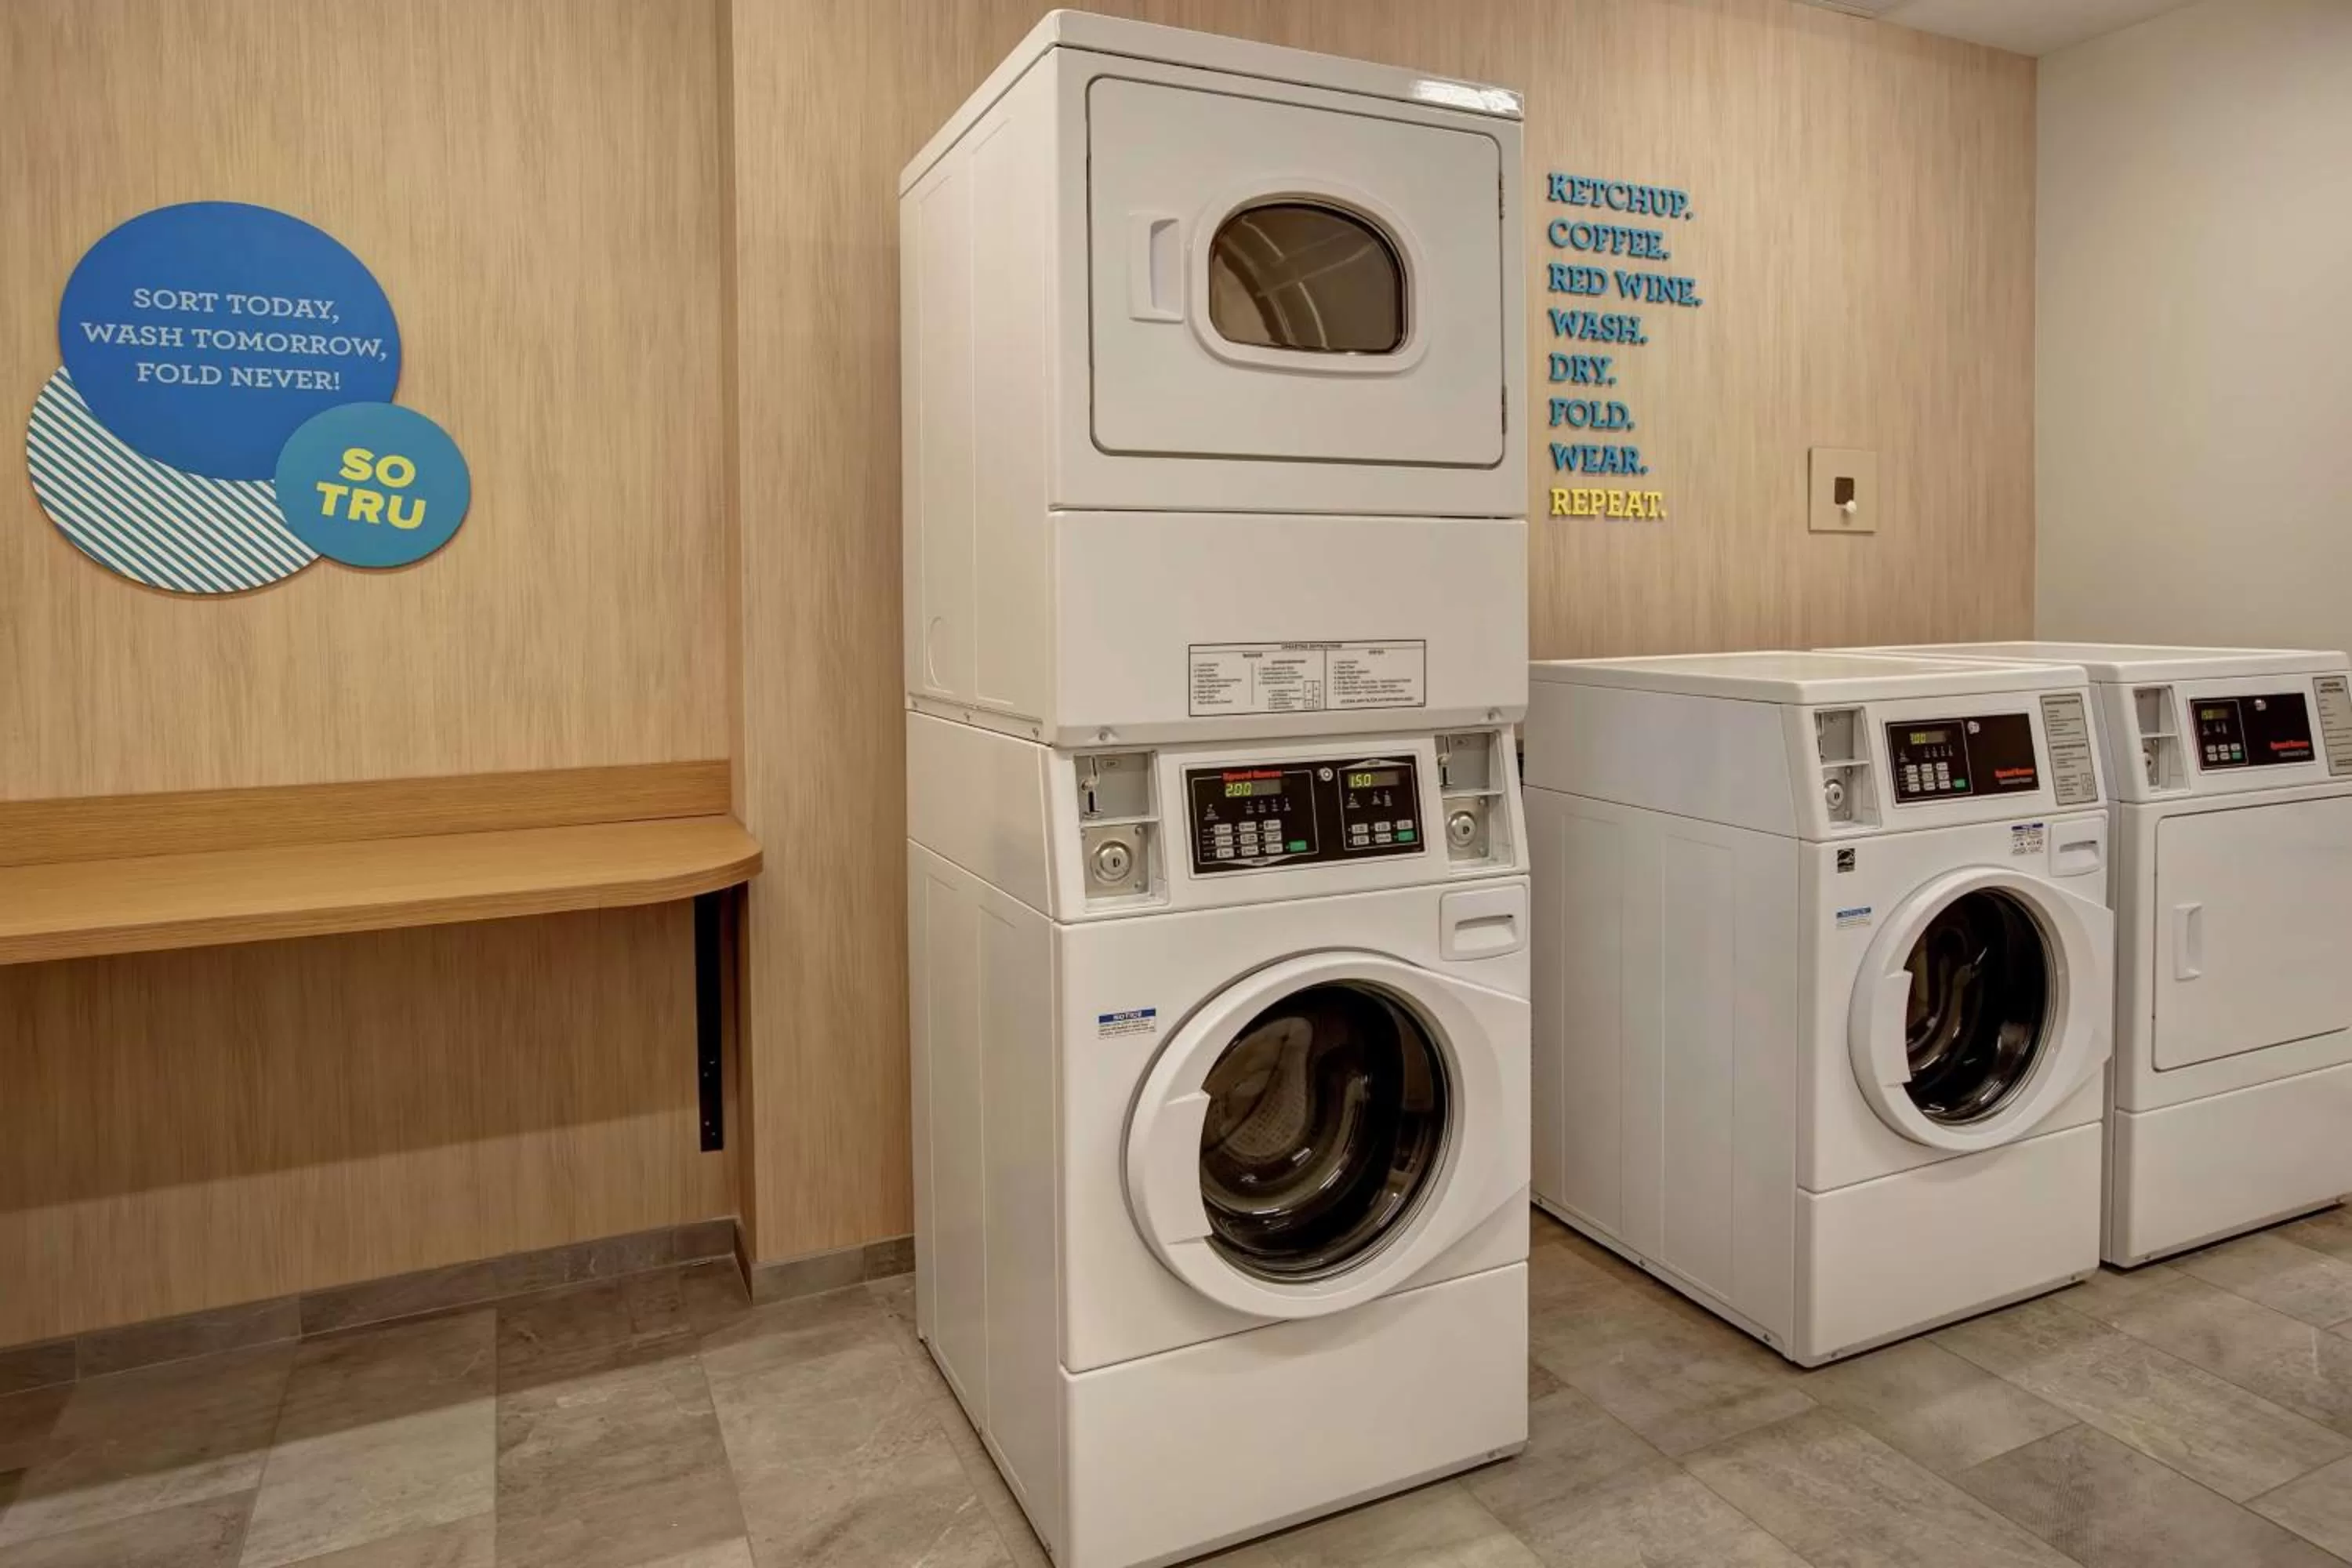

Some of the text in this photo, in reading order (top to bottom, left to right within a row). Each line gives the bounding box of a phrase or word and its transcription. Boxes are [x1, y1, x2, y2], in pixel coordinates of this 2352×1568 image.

[1548, 173, 1693, 219] KETCHUP.
[1548, 220, 1670, 260] COFFEE.
[1548, 263, 1703, 307] RED WINE.
[134, 288, 339, 325] SORT TODAY,
[81, 322, 387, 361] WASH TOMORROW,
[1548, 308, 1648, 343] WASH.
[137, 362, 340, 390] FOLD NEVER!
[1548, 353, 1616, 385] DRY.
[1548, 397, 1635, 430] FOLD.
[339, 448, 416, 488] SO
[1548, 442, 1649, 475] WEAR.
[316, 482, 426, 529] TRU
[1550, 488, 1668, 521] REPEAT.
